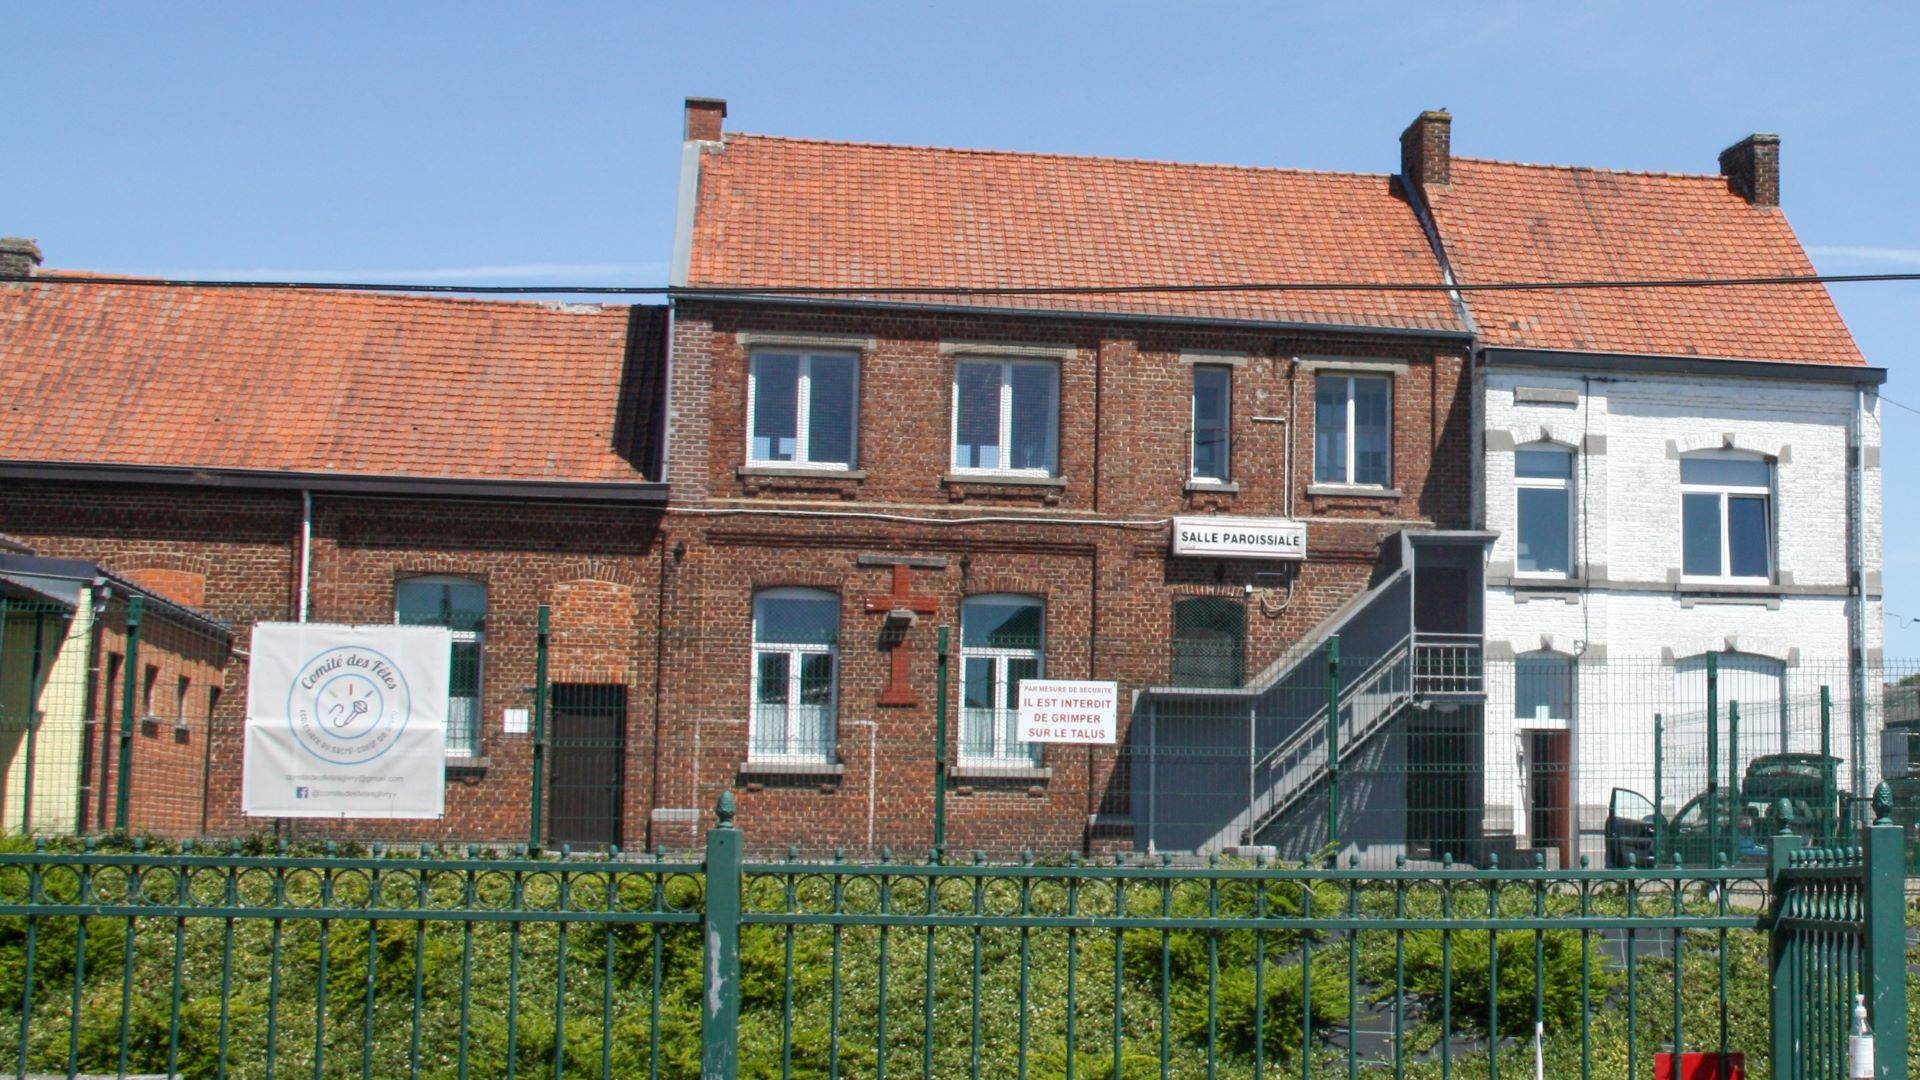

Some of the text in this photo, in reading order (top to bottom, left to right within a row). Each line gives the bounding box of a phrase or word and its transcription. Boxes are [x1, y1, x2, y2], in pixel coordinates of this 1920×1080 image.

[1181, 531, 1300, 546] SALLE PAROISSIALE
[301, 654, 343, 690] Comité
[347, 654, 369, 668] des
[1023, 698, 1112, 709] IL EST INTERDIT
[1034, 713, 1101, 724] DE GRIMPER
[1028, 728, 1105, 739] SUR LE TALUS
